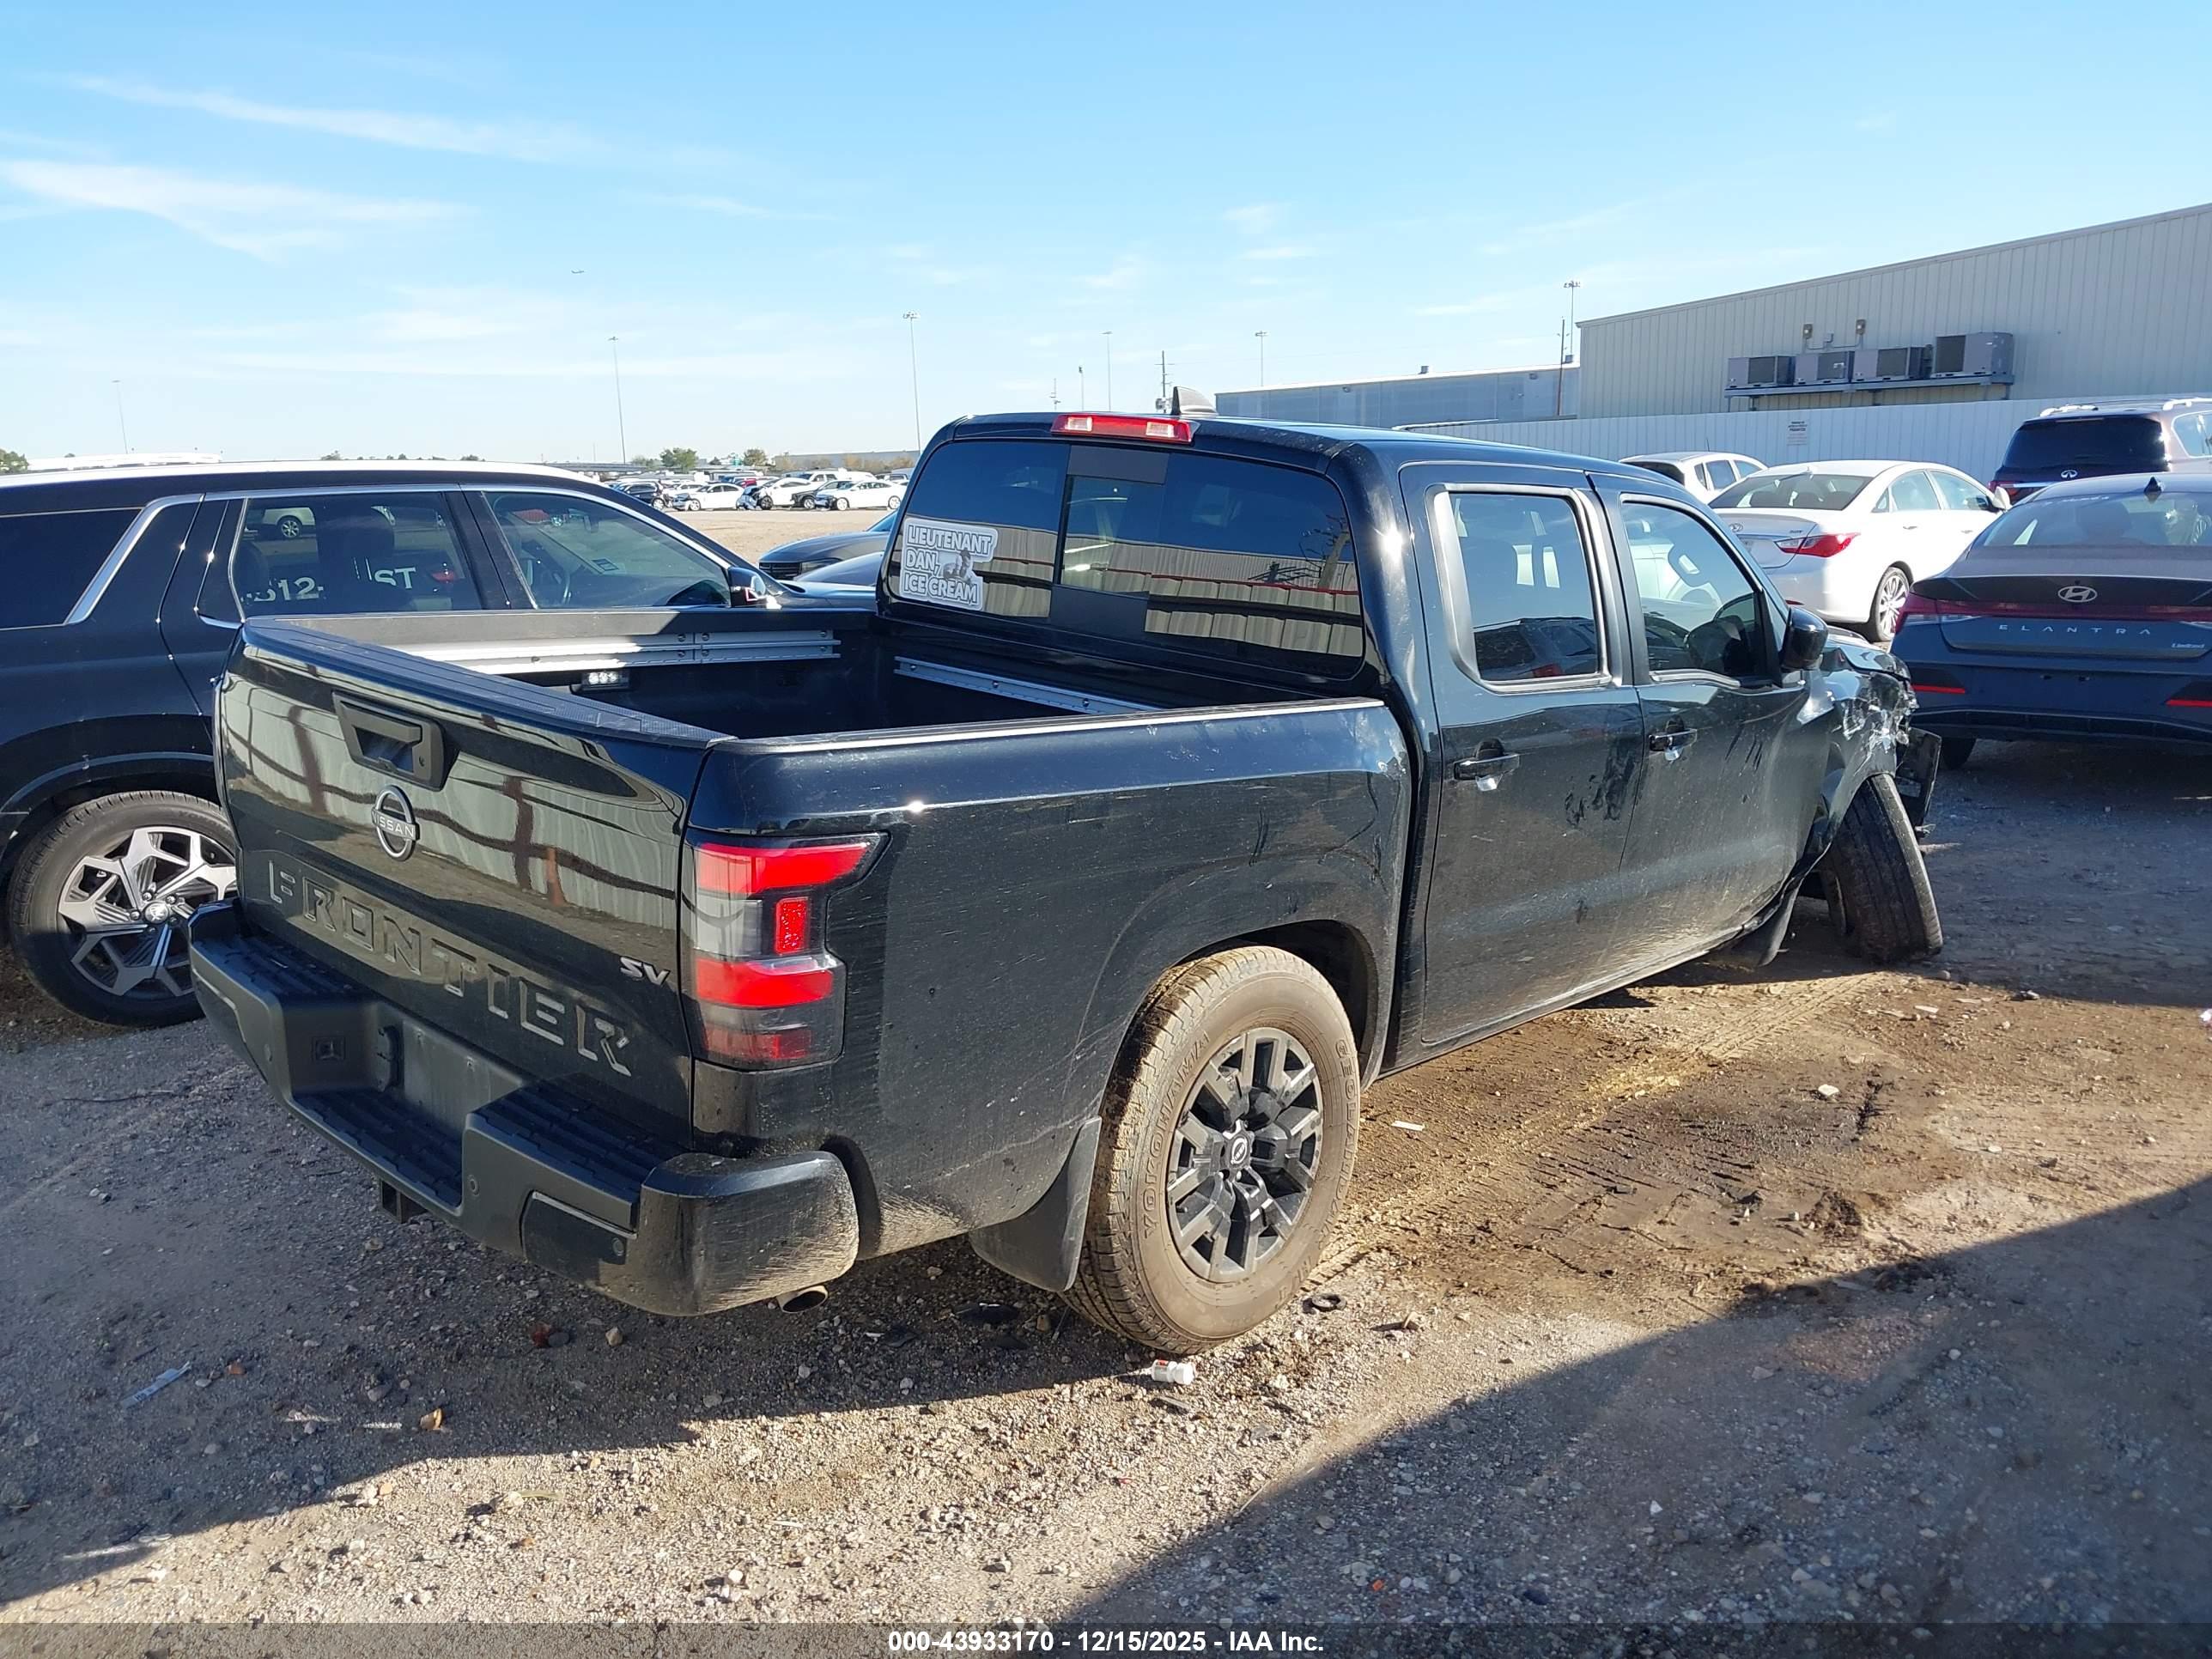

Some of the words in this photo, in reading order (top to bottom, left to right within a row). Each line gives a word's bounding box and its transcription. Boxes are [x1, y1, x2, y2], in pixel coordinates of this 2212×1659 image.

[908, 525, 993, 555] LIEUTENANT
[906, 549, 940, 575] DAN,
[904, 574, 927, 594] ICE
[927, 578, 978, 604] CREAM
[1998, 624, 2151, 635] ELANTRA
[371, 811, 414, 838] NISSAN
[267, 859, 632, 1077] FRONTIER
[620, 956, 671, 986] SV
[1143, 1030, 1211, 1239] YOKOHAMA
